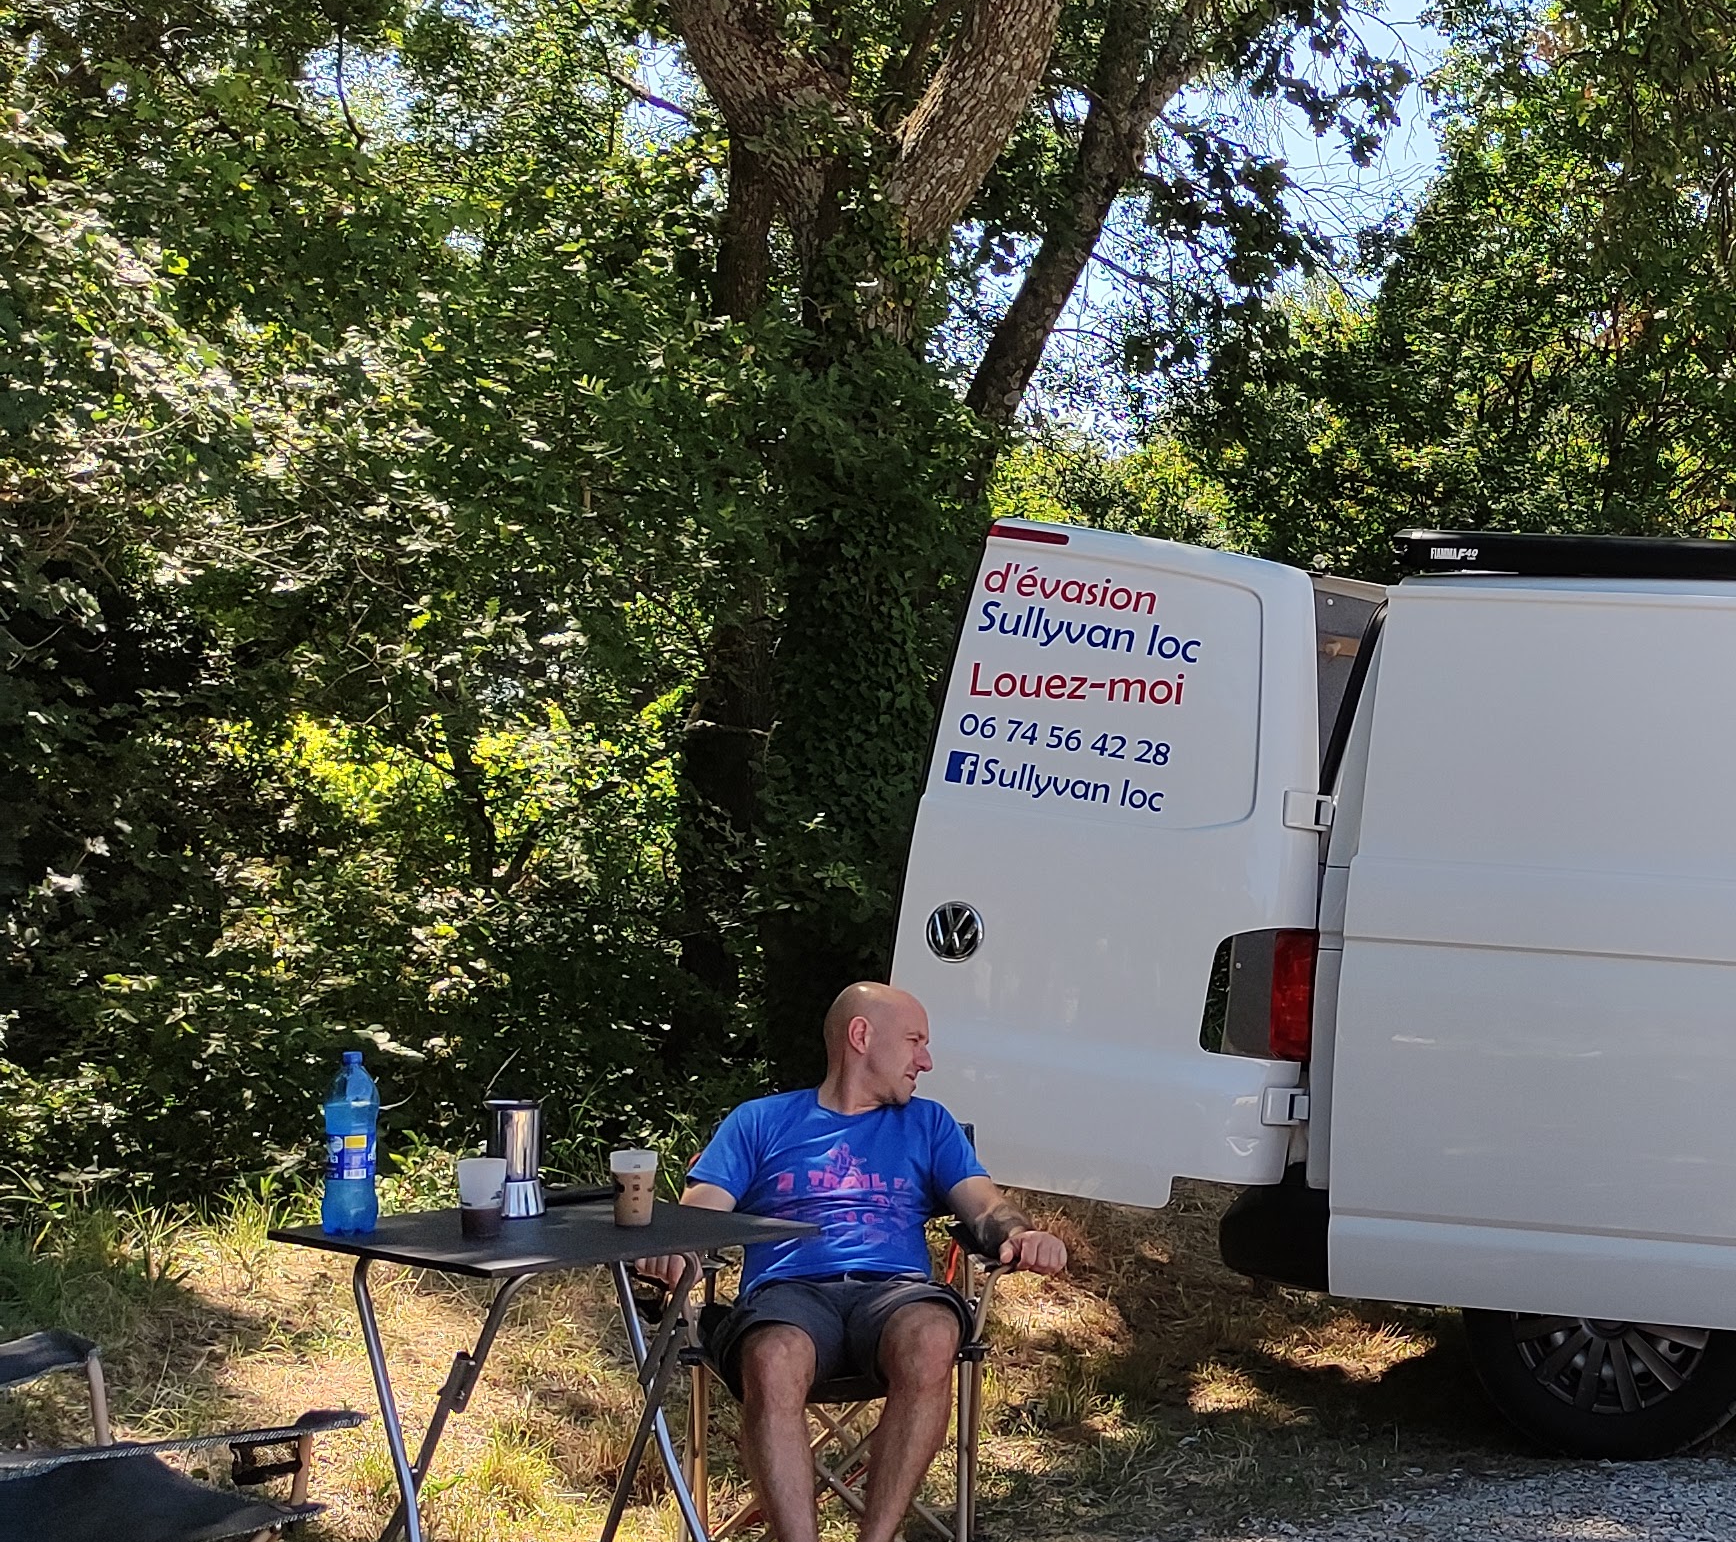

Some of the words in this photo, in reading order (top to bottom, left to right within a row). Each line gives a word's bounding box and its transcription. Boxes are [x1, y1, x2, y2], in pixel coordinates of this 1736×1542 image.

[984, 562, 1157, 615] d'évasion
[977, 601, 1135, 653] Sullyvan
[1146, 624, 1202, 663] loc
[969, 662, 1185, 705] Louez-moi
[959, 713, 997, 739] 06
[1006, 719, 1038, 746] 74
[1045, 726, 1082, 752] 56
[1090, 732, 1127, 759] 42
[1134, 739, 1171, 766] 28
[981, 758, 1110, 804] Sullyvan
[1120, 779, 1164, 812] loc
[808, 1170, 888, 1192] TRAIL
